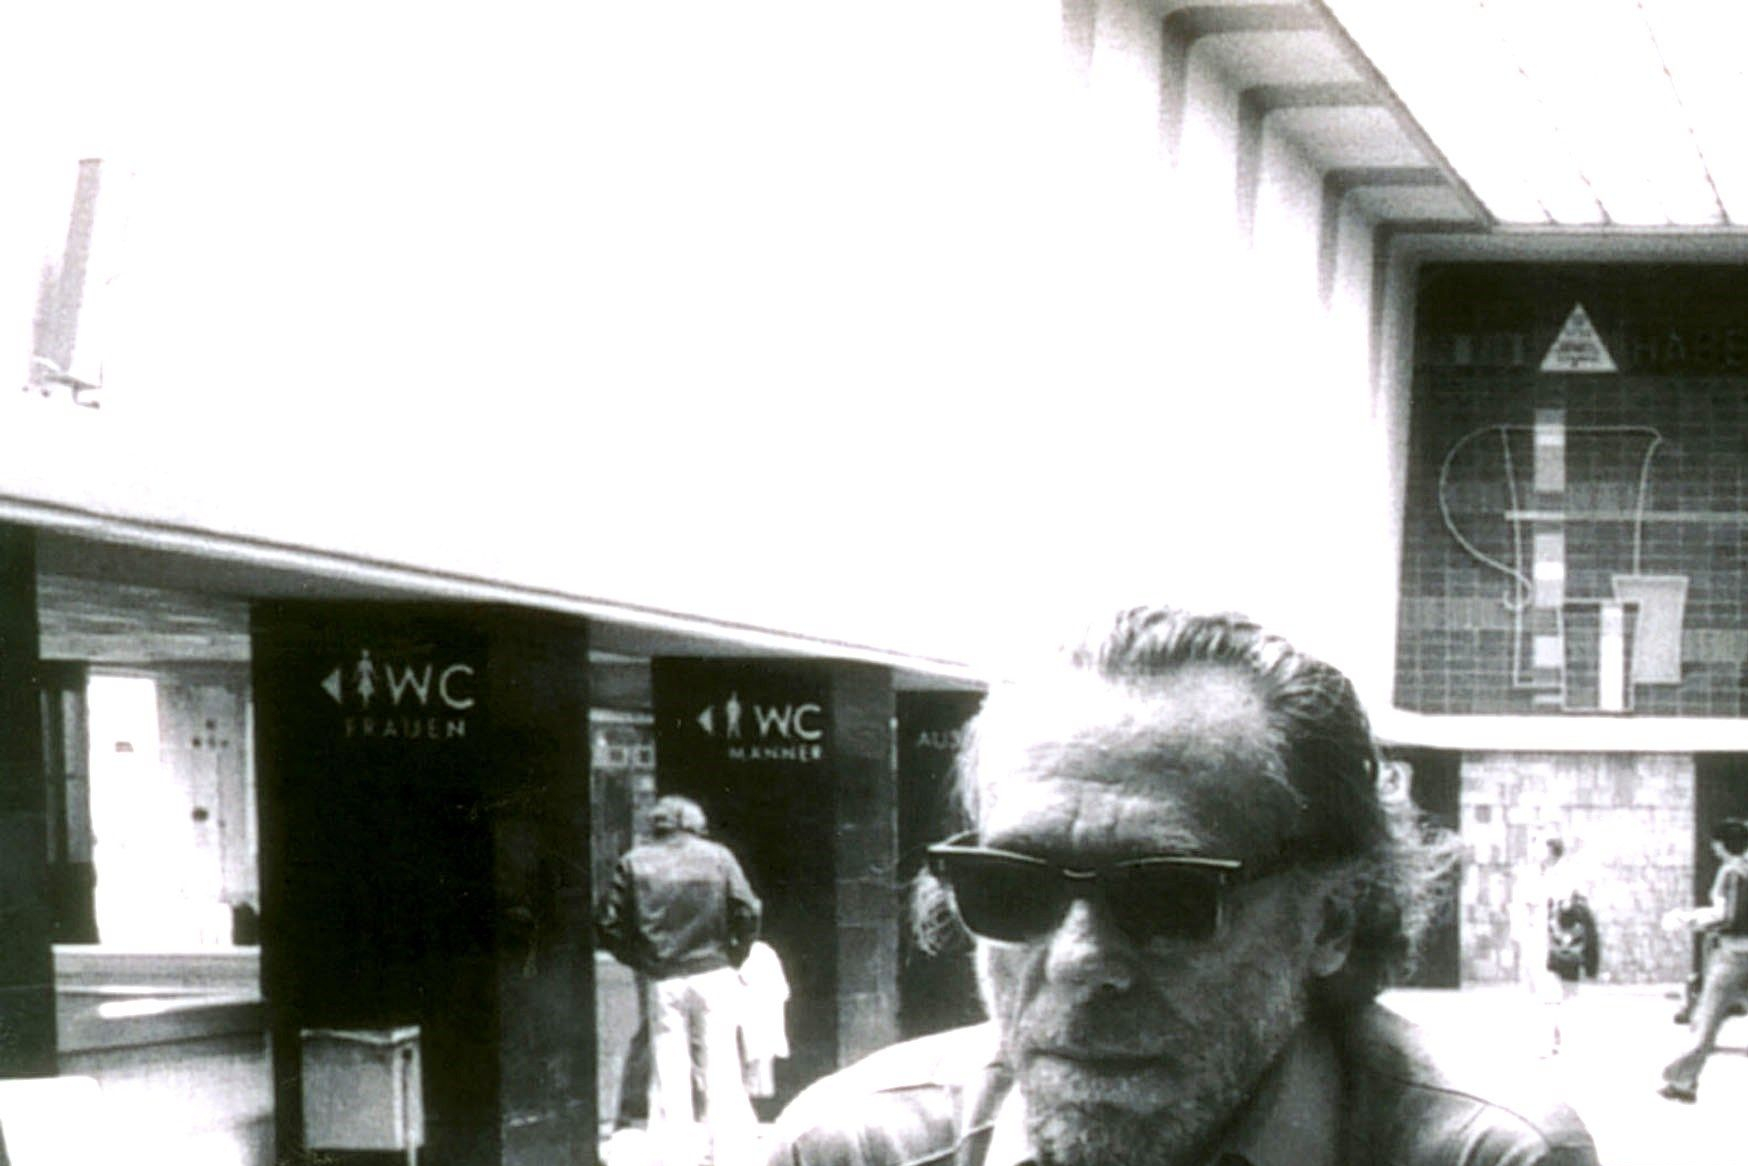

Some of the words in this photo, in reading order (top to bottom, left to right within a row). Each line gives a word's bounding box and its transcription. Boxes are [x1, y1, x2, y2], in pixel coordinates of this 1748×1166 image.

[383, 663, 476, 711] WC
[344, 716, 467, 739] FRAUEN
[753, 703, 823, 741] WC
